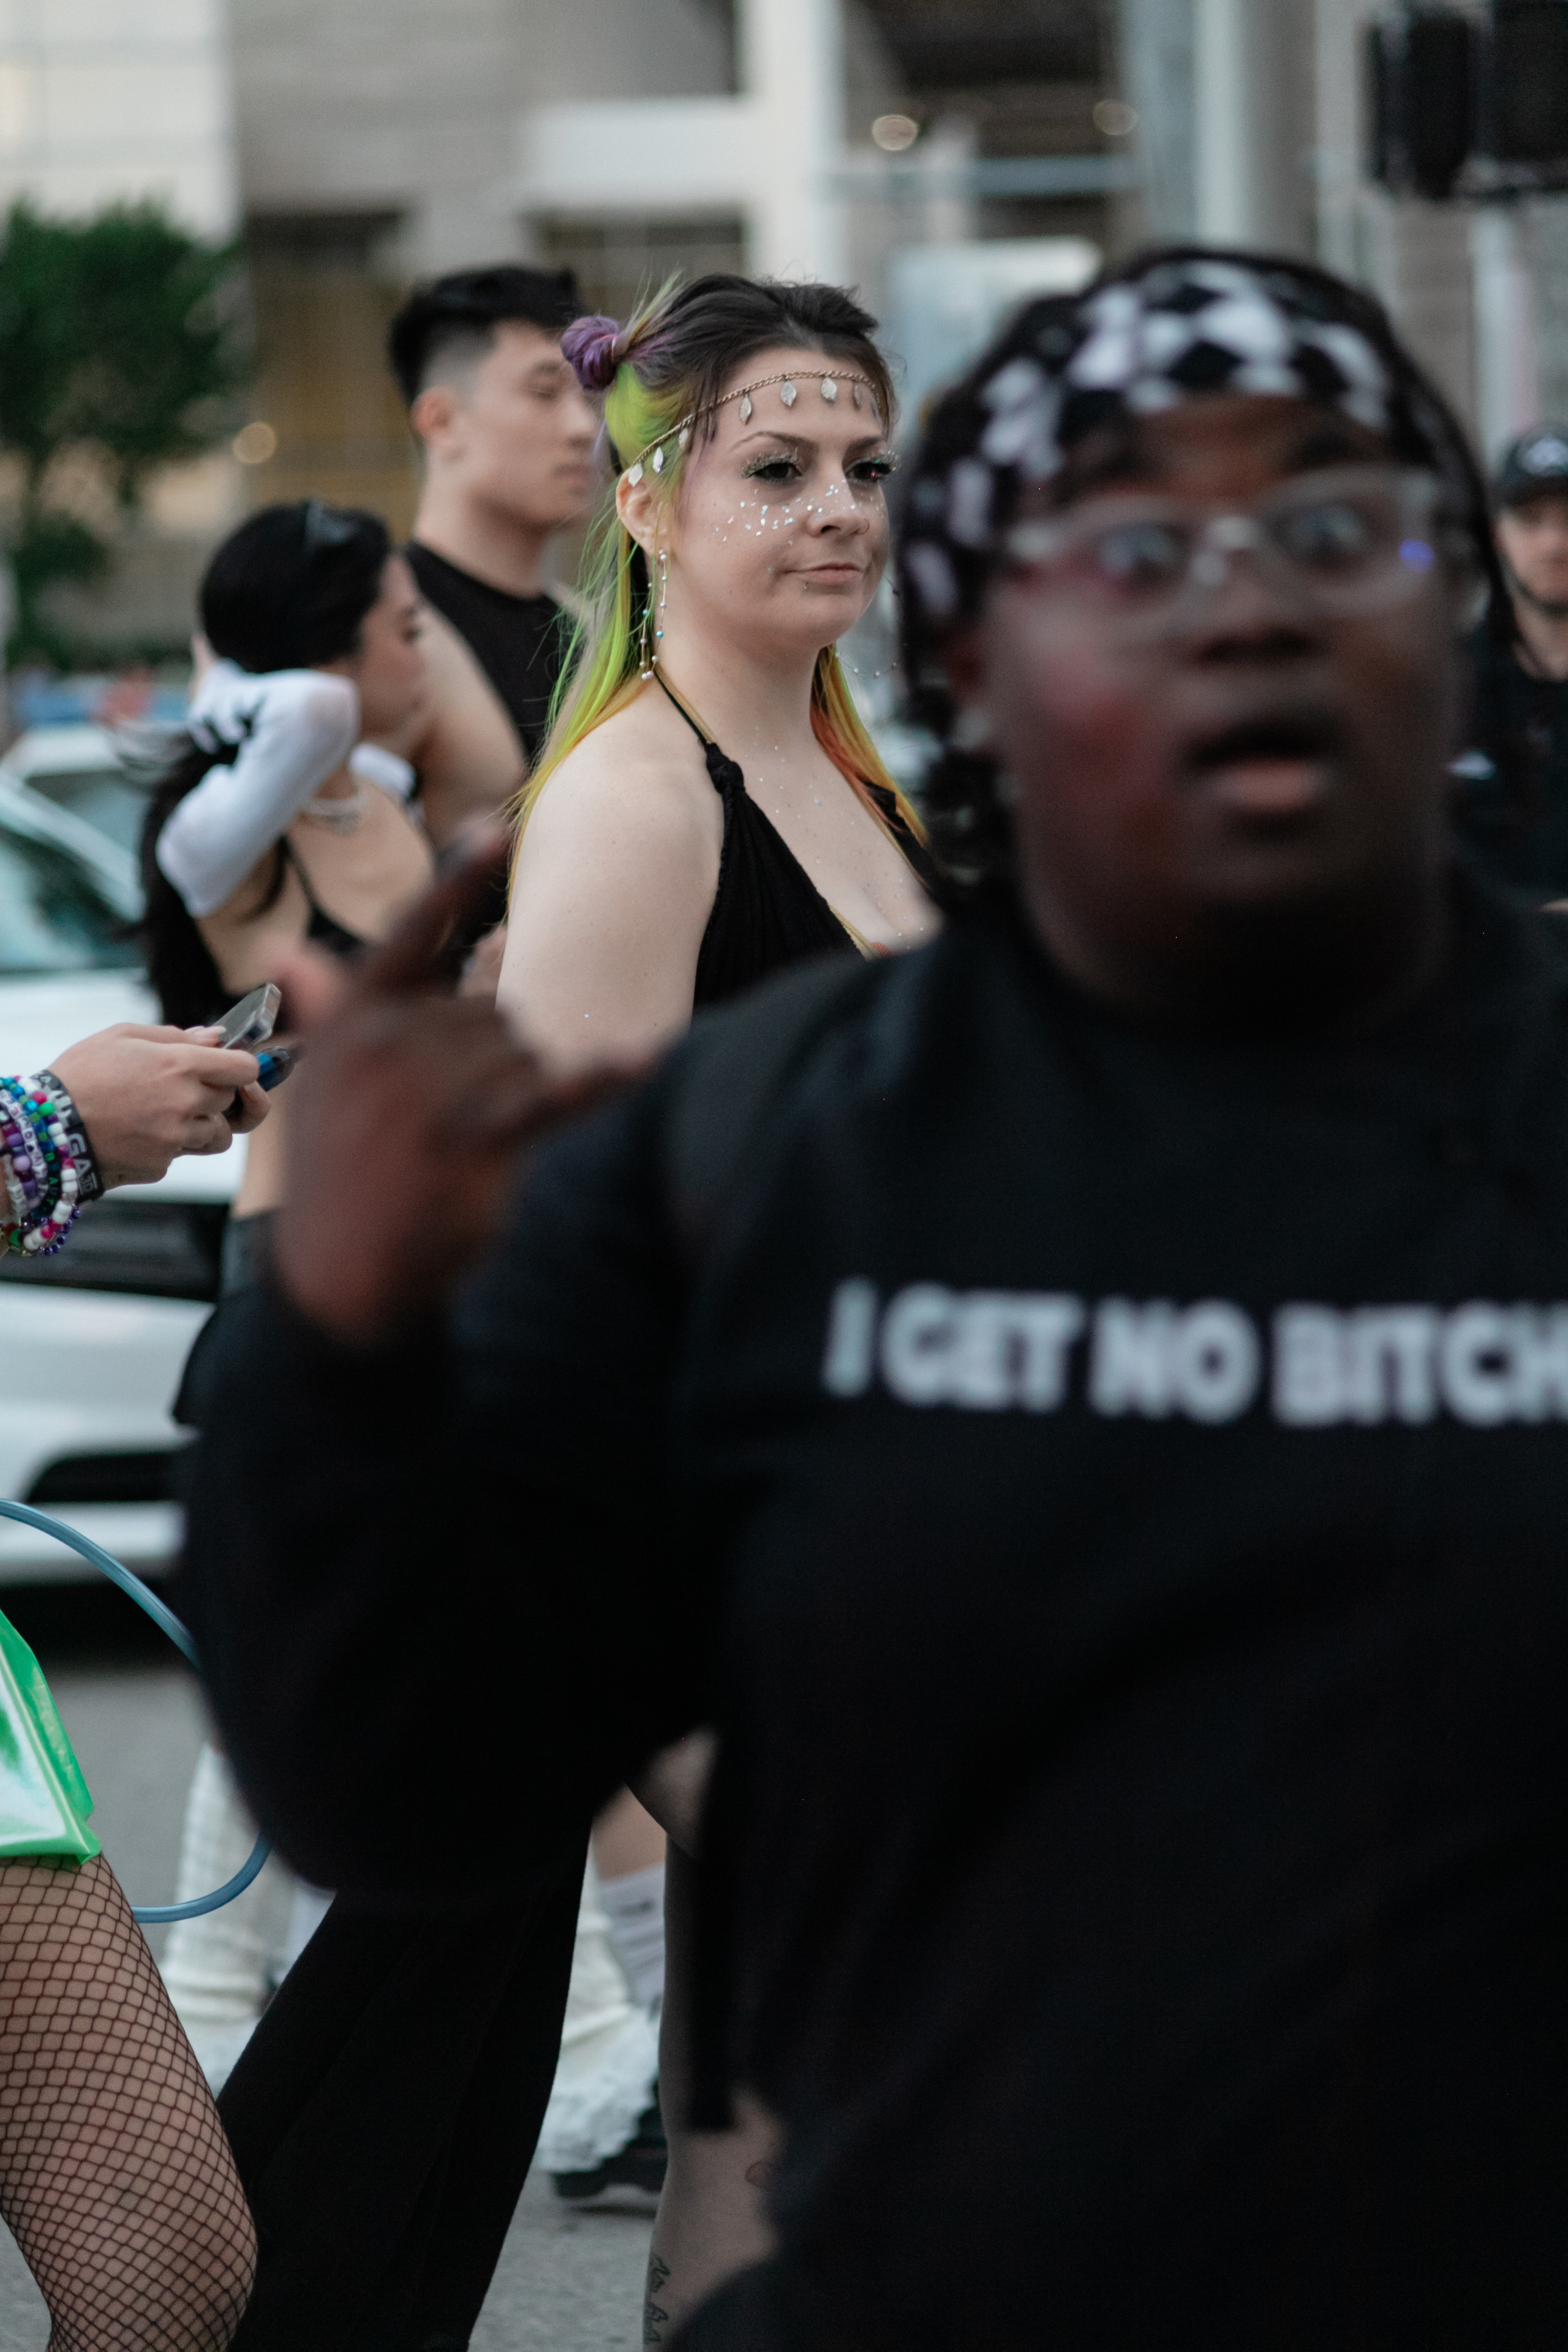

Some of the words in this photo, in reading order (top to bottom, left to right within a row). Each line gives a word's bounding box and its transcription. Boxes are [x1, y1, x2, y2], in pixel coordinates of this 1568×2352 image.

[824, 1281, 876, 1396] I
[878, 1284, 1085, 1411] GET
[1089, 1298, 1260, 1422] NO
